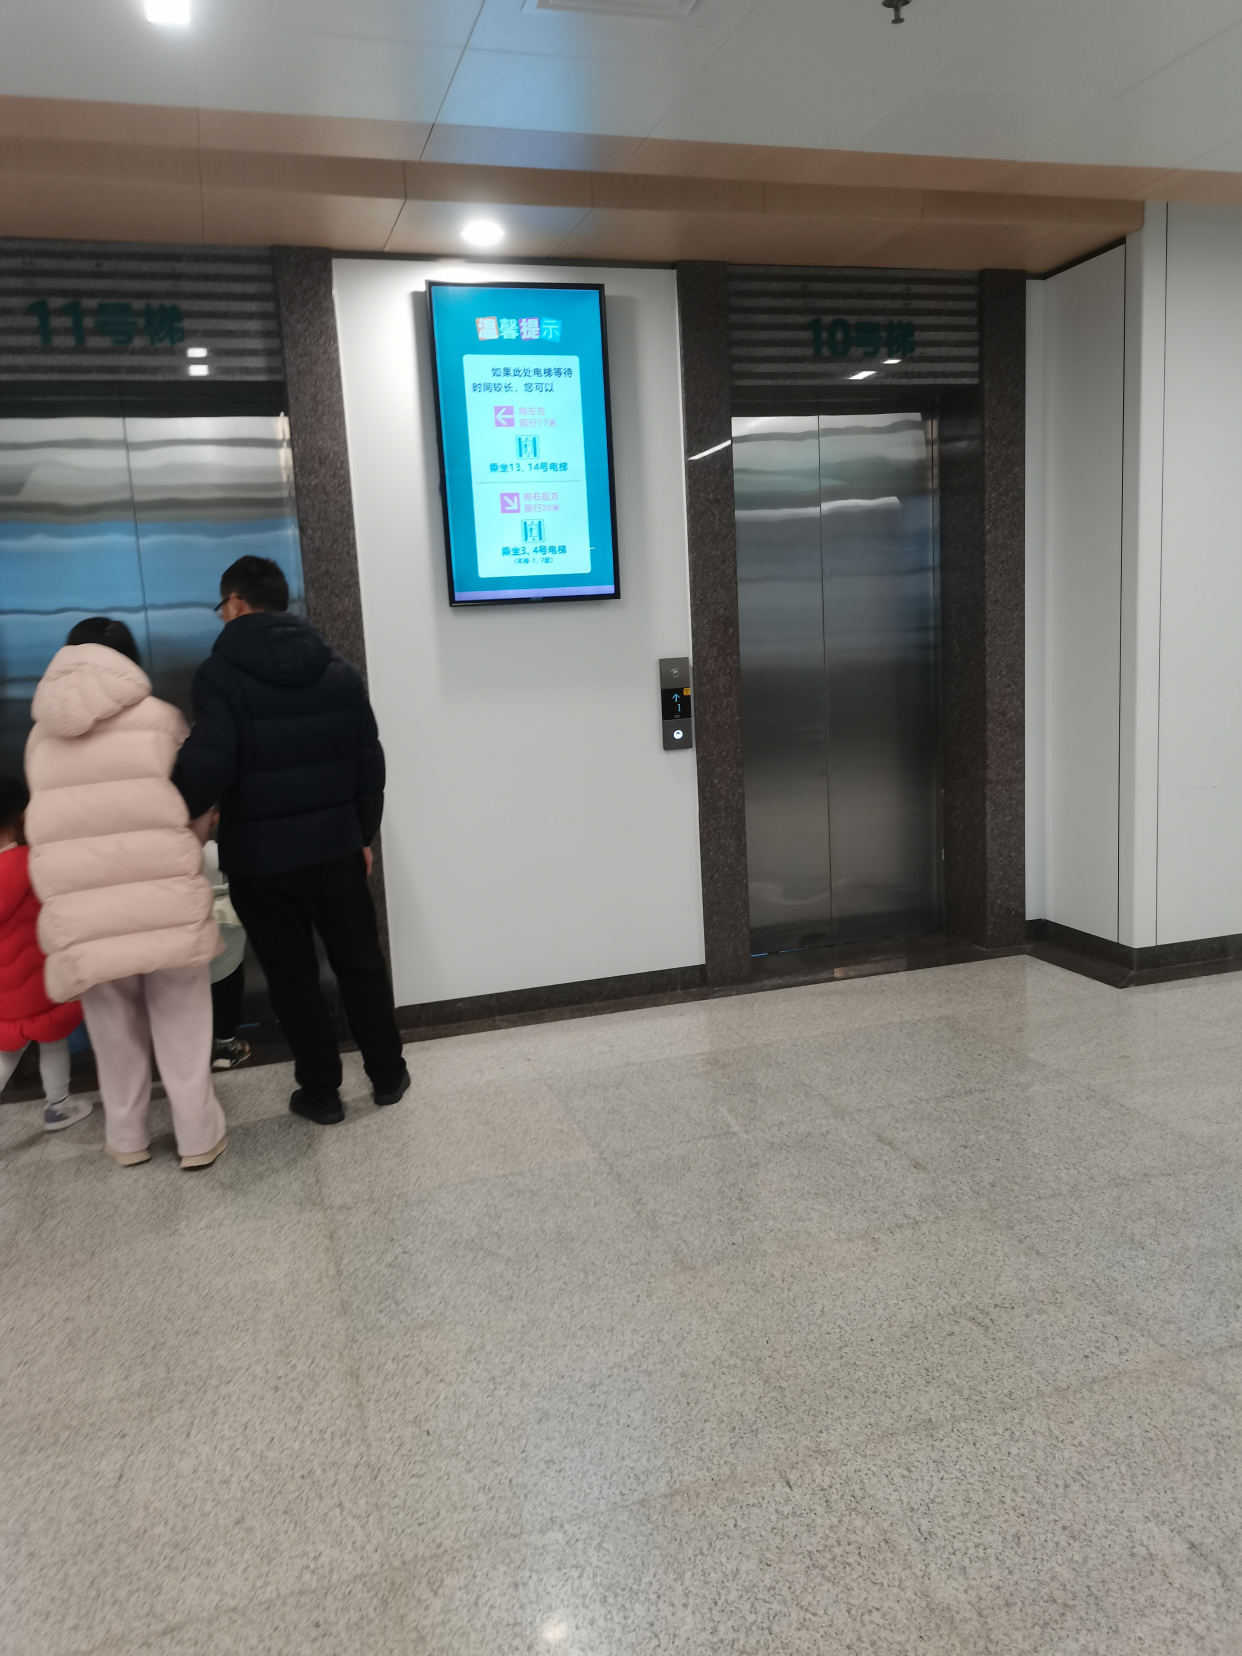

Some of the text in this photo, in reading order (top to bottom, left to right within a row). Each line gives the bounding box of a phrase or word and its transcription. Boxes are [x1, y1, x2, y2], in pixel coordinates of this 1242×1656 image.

[477, 317, 560, 340] 温馨提示
[491, 366, 574, 378] 如果此处电梯等待
[472, 382, 554, 393] 时间较长，您可以
[518, 406, 546, 416] 向左方
[489, 462, 569, 473] 乘坐13、14号电梯
[523, 492, 559, 502] 向右后方
[501, 545, 568, 556] 乘坐3、4号电梯
